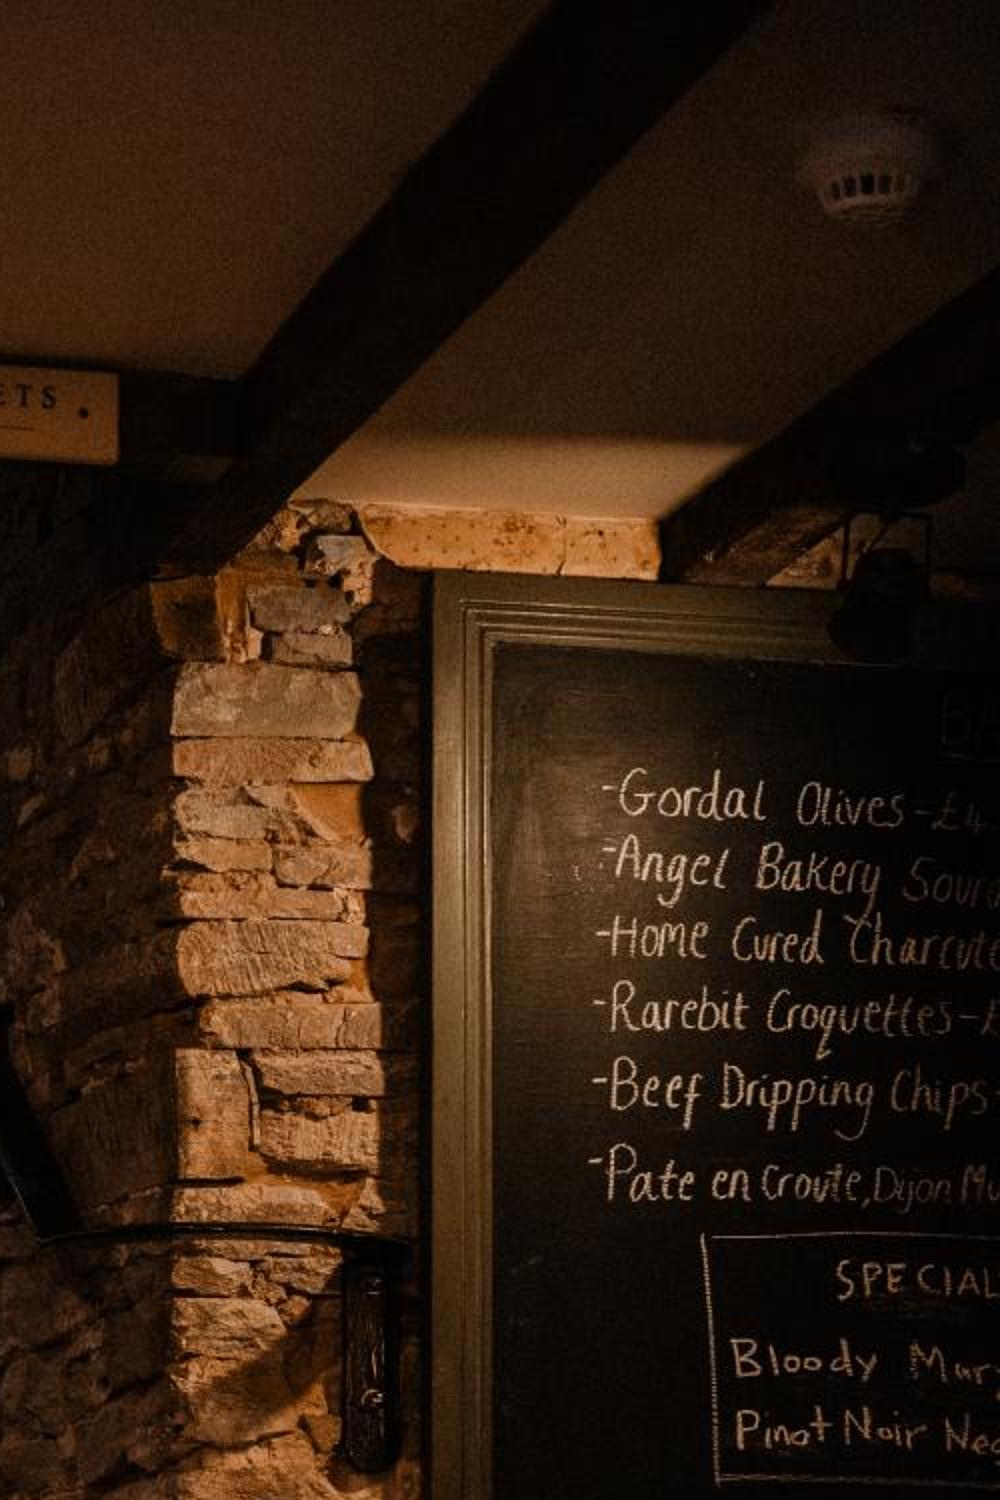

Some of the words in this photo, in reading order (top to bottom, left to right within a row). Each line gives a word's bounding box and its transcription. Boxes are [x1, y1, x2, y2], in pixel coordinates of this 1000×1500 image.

[754, 841, 882, 918] Bakery
[731, 908, 825, 965] Cured
[718, 1060, 875, 1142] Dripping
[710, 1167, 753, 1203] en
[728, 1335, 881, 1383] Bloody
[735, 1404, 834, 1452] Pinot
[843, 1404, 929, 1452] Noir
